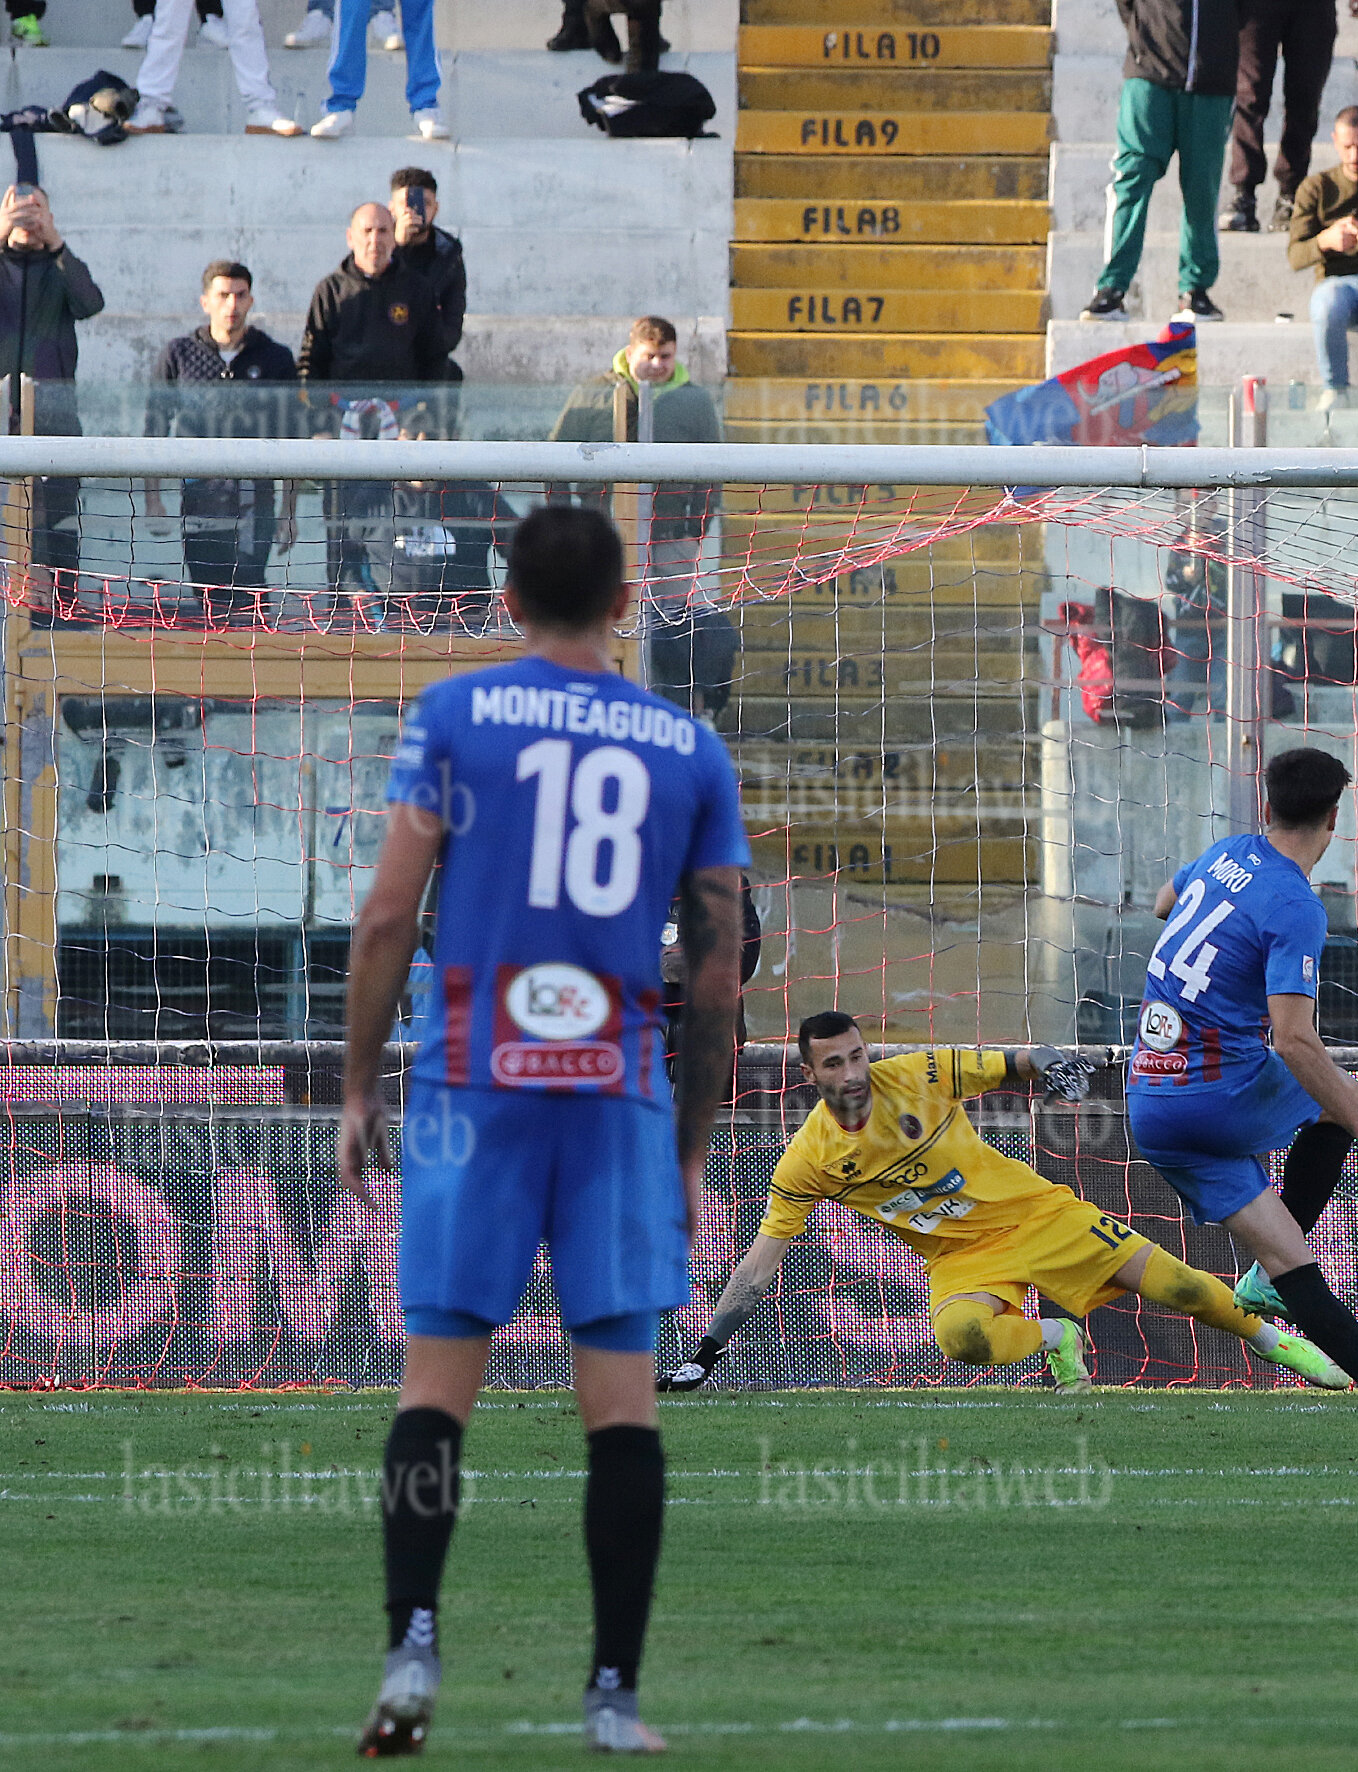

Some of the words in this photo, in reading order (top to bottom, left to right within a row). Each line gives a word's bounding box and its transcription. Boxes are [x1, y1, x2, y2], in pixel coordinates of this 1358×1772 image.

[822, 32, 896, 60] FILA
[906, 32, 940, 60] 10
[471, 685, 696, 756] MONTEAGUDO
[515, 738, 652, 918] 18
[1206, 851, 1254, 894] MORO
[1147, 878, 1236, 1003] 24
[1089, 1216, 1133, 1251] 12
